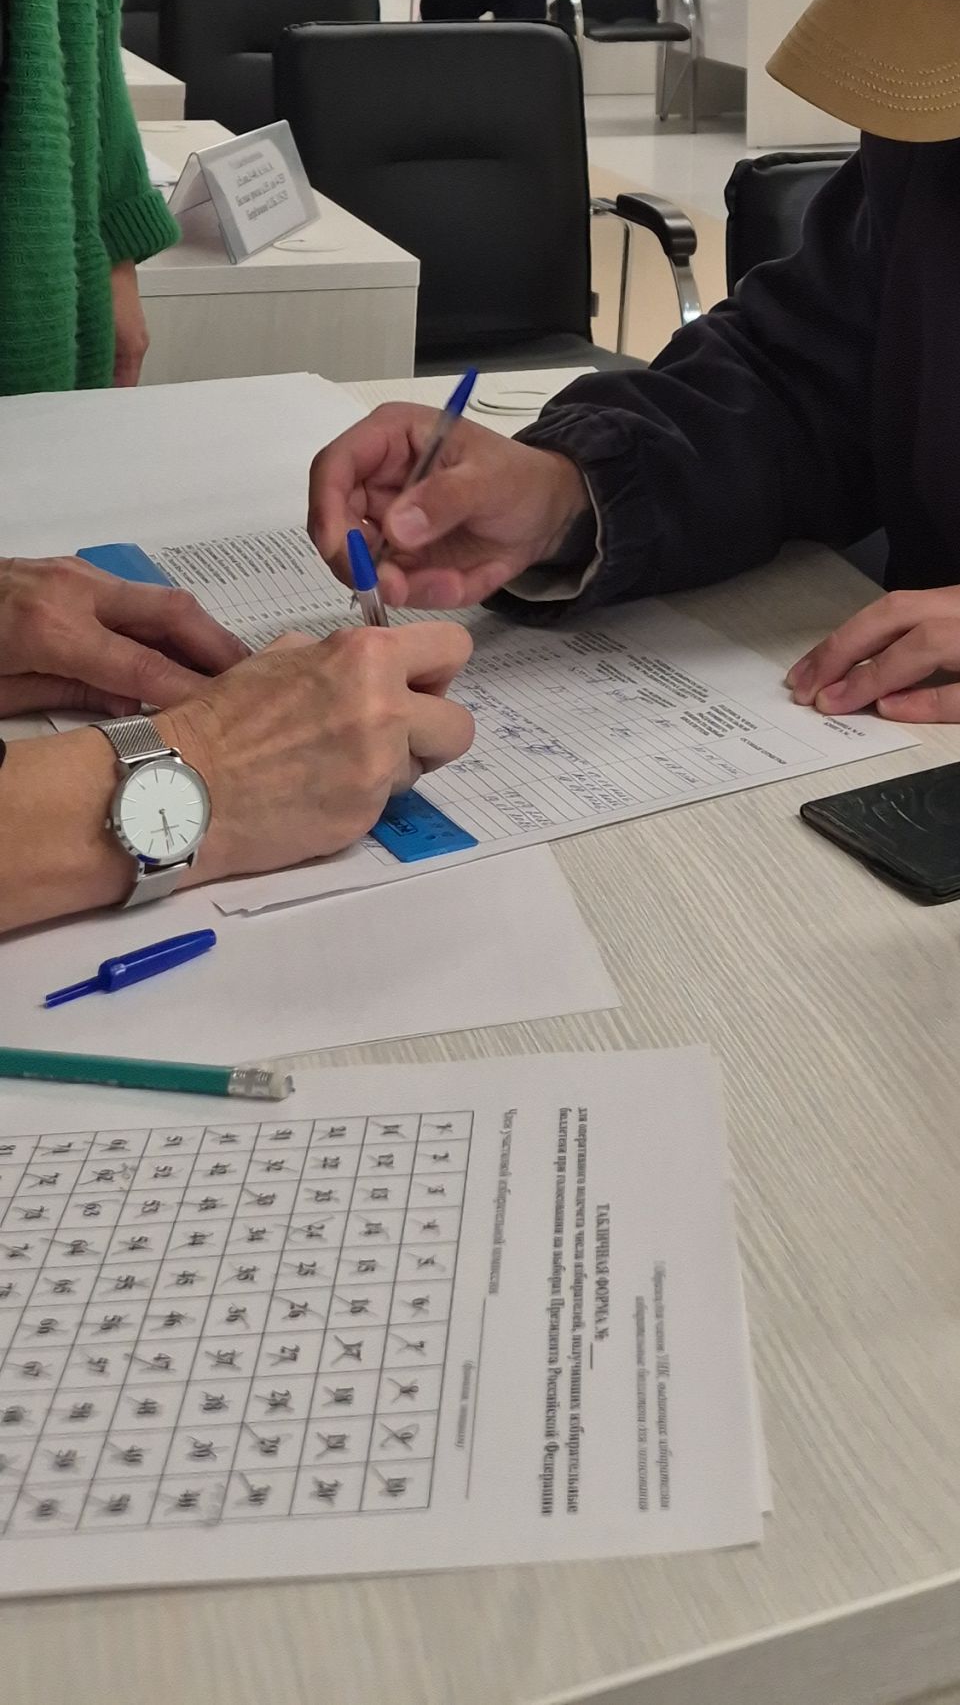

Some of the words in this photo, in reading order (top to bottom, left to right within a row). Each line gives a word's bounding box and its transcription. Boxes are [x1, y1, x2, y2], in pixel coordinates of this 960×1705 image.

[578, 1107, 588, 1123] для
[552, 1155, 567, 1173] при
[553, 1236, 564, 1249] на
[574, 1230, 585, 1260] числа
[595, 1203, 610, 1275] ТАБЛИЧНАЯ
[547, 1250, 566, 1296] выборах
[570, 1261, 588, 1333] избирателей,
[594, 1275, 609, 1324] ФОРМА
[546, 1297, 565, 1364] Президента
[544, 1367, 562, 1438] Российской
[567, 1334, 582, 1410] получивших
[538, 1441, 560, 1516] Федерации
[564, 1412, 585, 1515] избирательные
